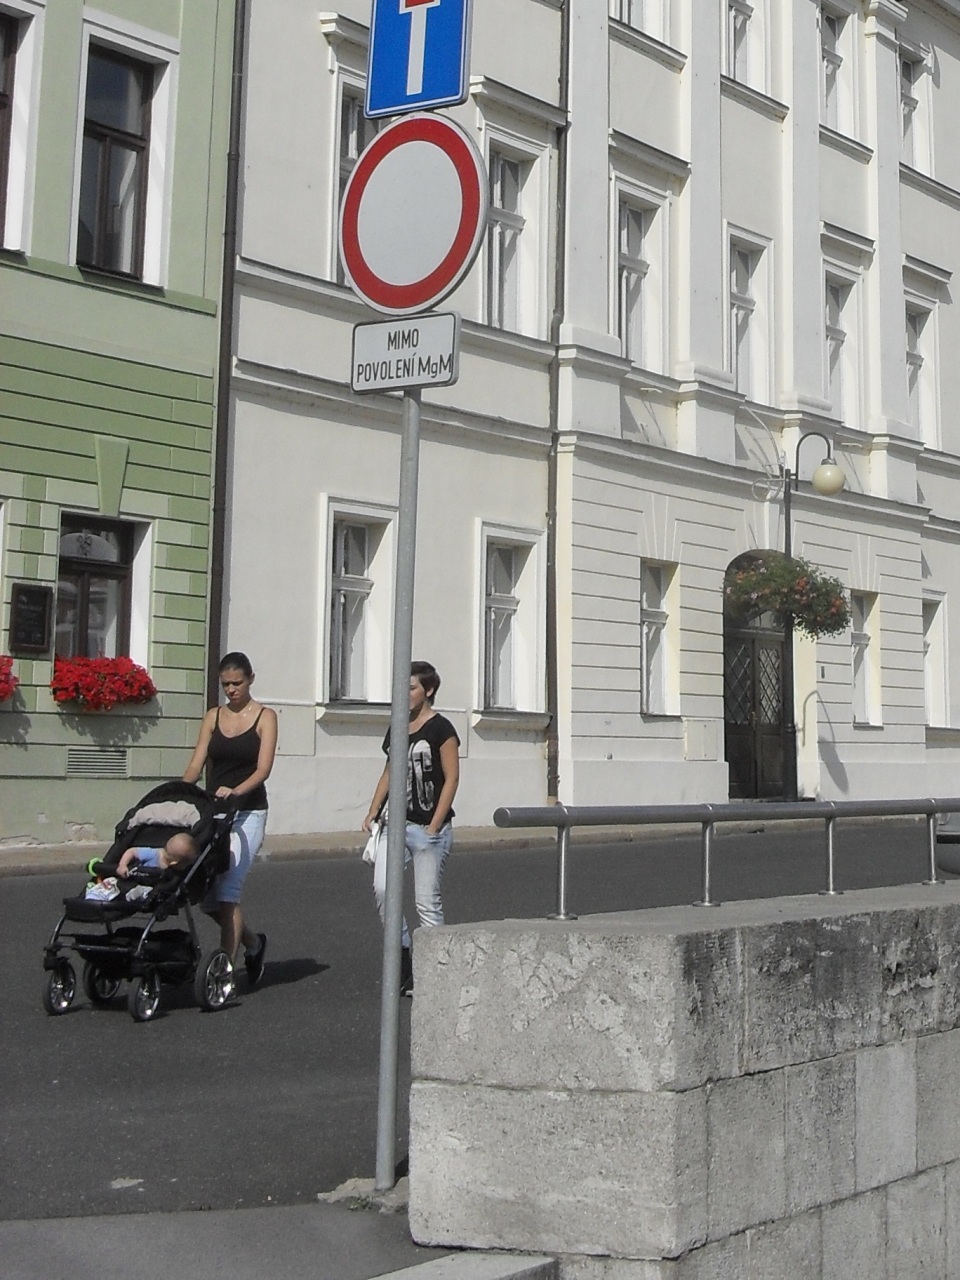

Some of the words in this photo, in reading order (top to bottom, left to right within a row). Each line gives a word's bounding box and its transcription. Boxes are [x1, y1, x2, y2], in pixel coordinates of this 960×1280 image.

[387, 328, 419, 351] MIMO
[356, 352, 417, 383] POVOLENÍ
[417, 353, 453, 379] MgM
